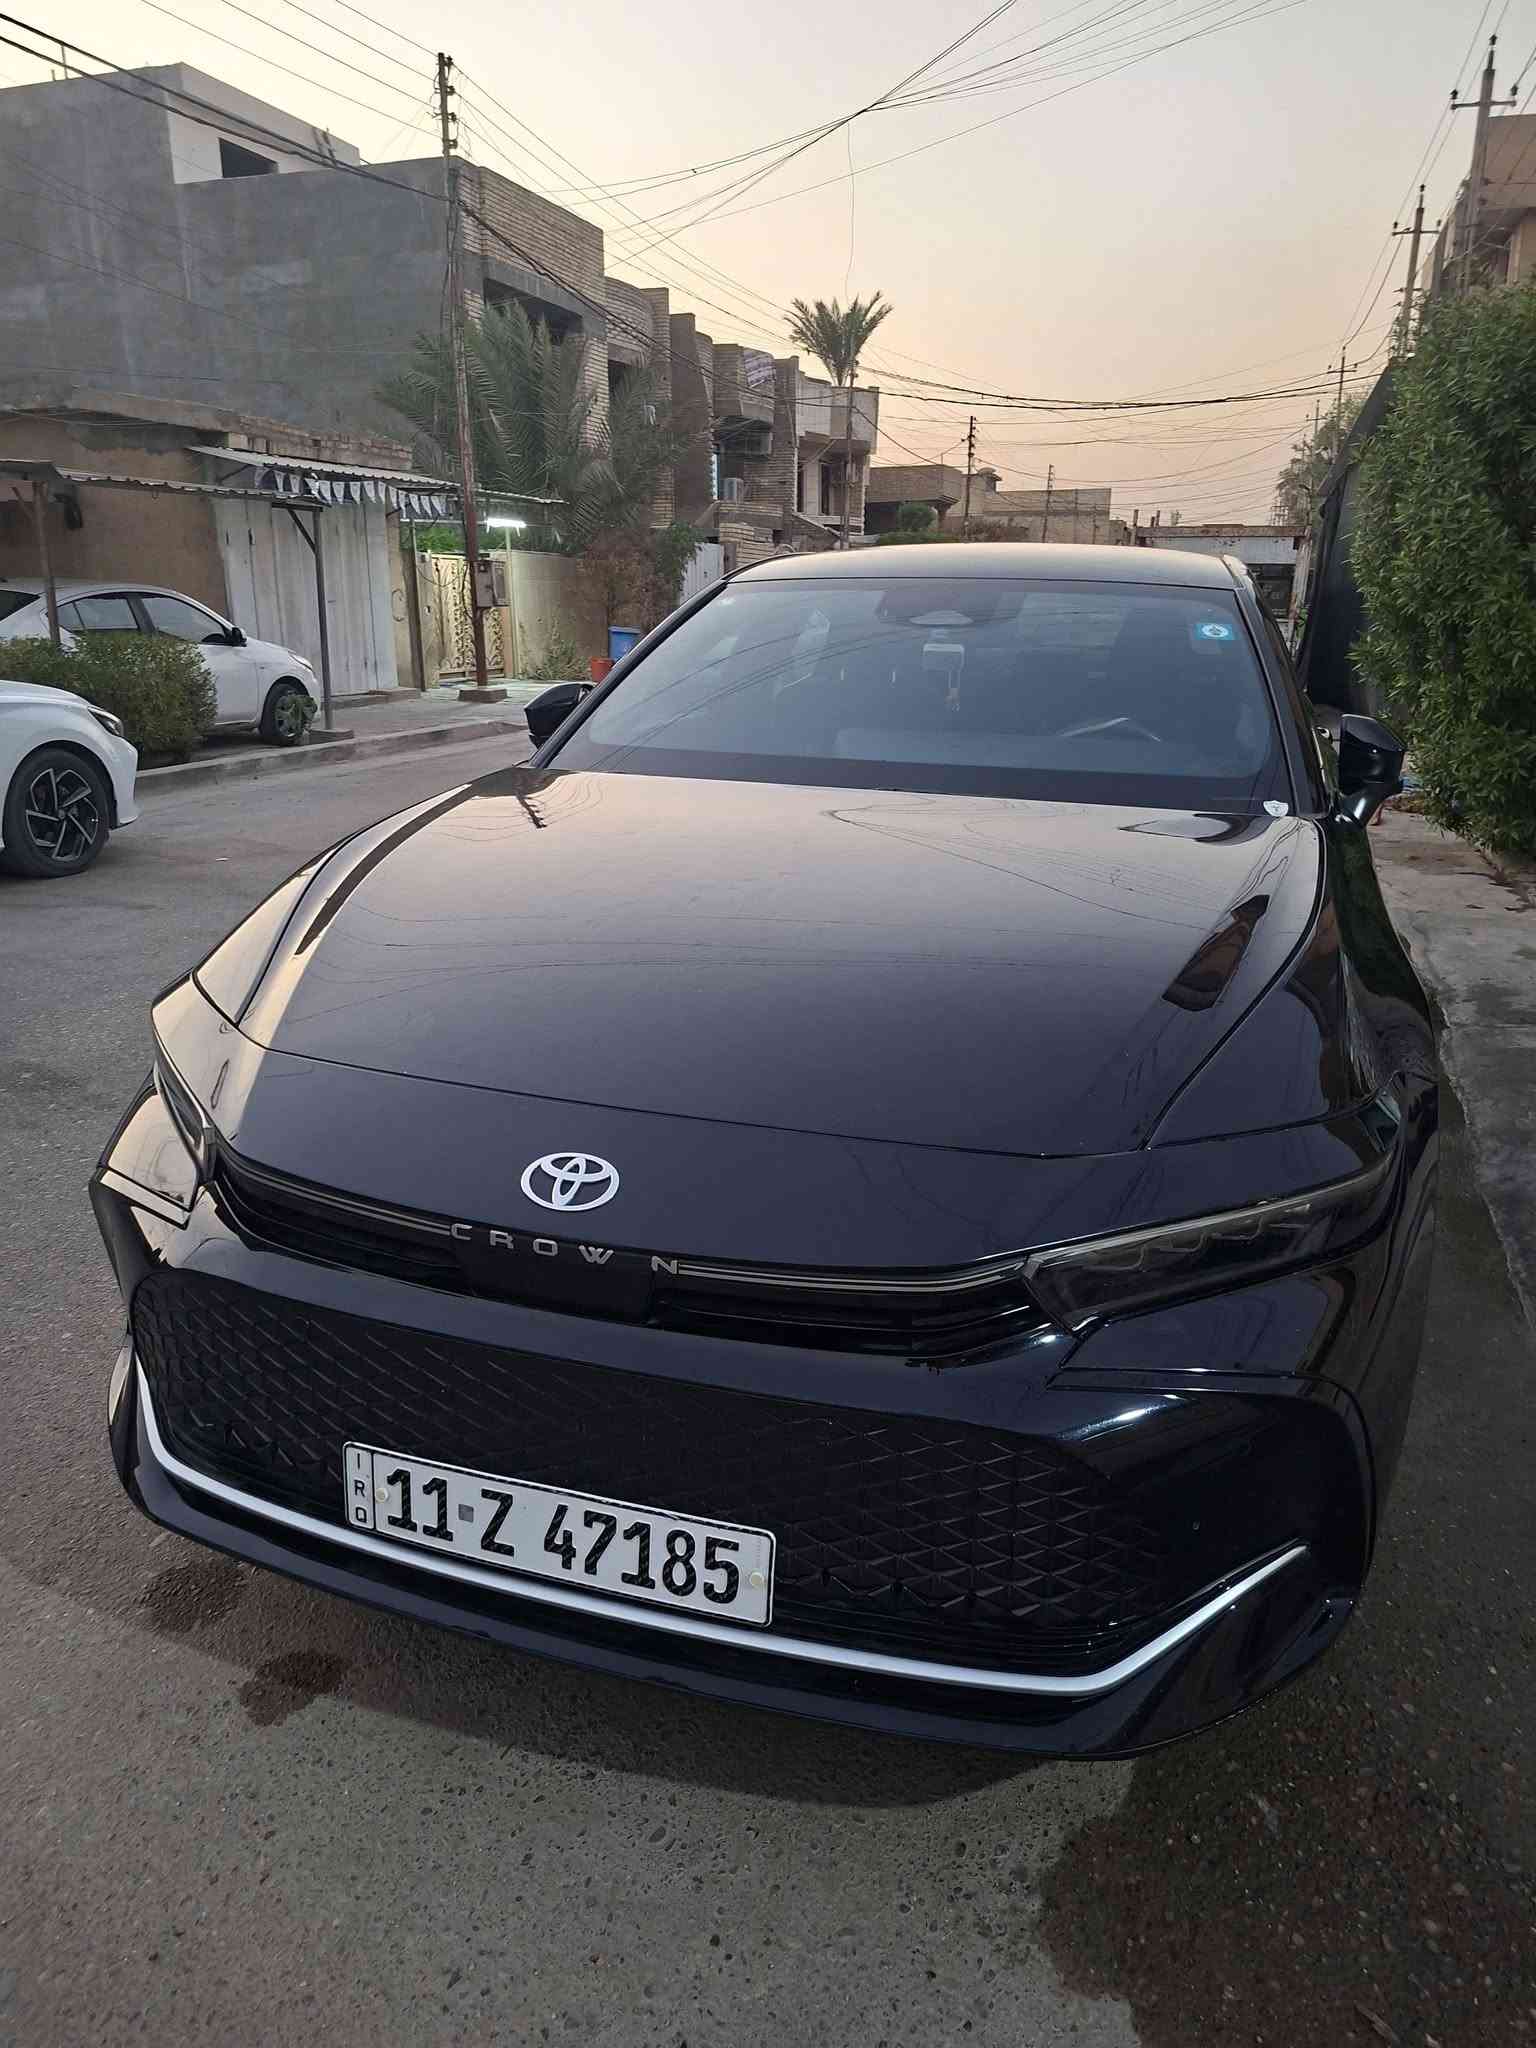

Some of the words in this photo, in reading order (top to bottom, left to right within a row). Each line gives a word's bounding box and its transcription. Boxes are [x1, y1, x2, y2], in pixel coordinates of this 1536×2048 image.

[451, 1223, 678, 1274] CROWN
[386, 1468, 454, 1542] 11
[480, 1488, 515, 1557] Z
[543, 1504, 740, 1604] 47185
